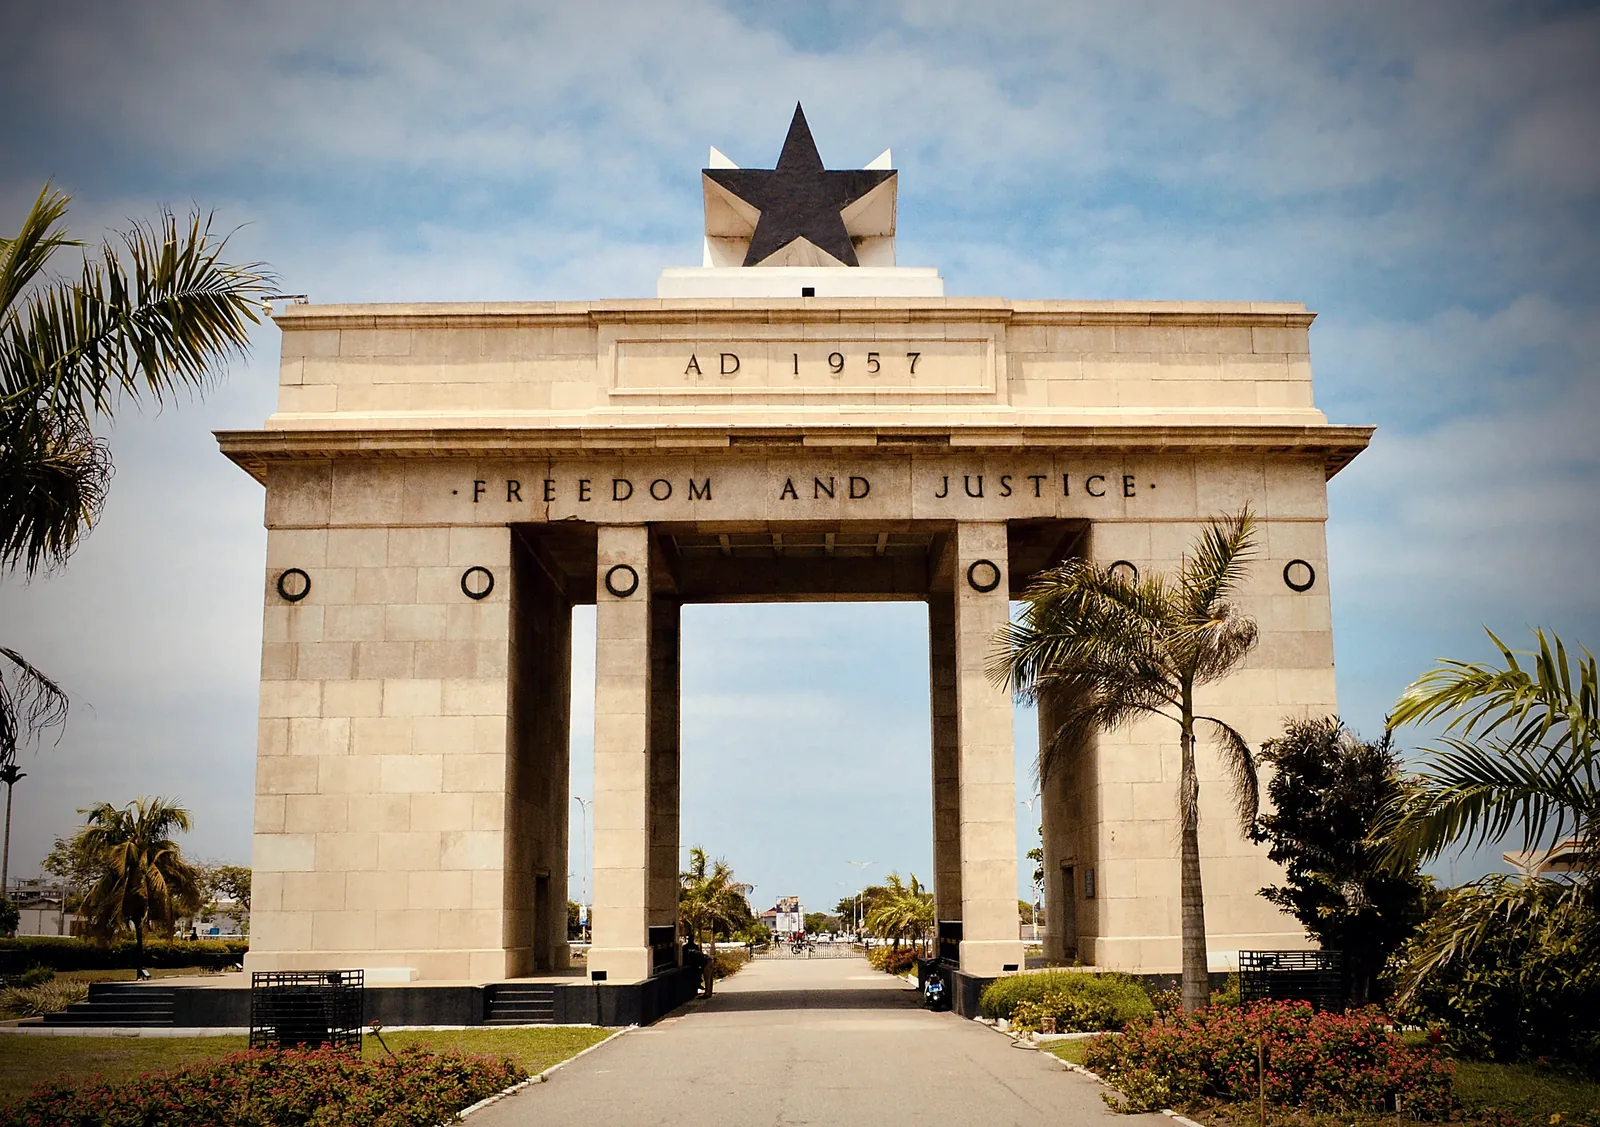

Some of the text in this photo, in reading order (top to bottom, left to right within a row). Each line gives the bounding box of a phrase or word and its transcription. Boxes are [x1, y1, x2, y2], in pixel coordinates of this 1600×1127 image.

[684, 352, 921, 375] AD 1957
[473, 474, 1136, 503] FREEDOM AND JUSTICE
